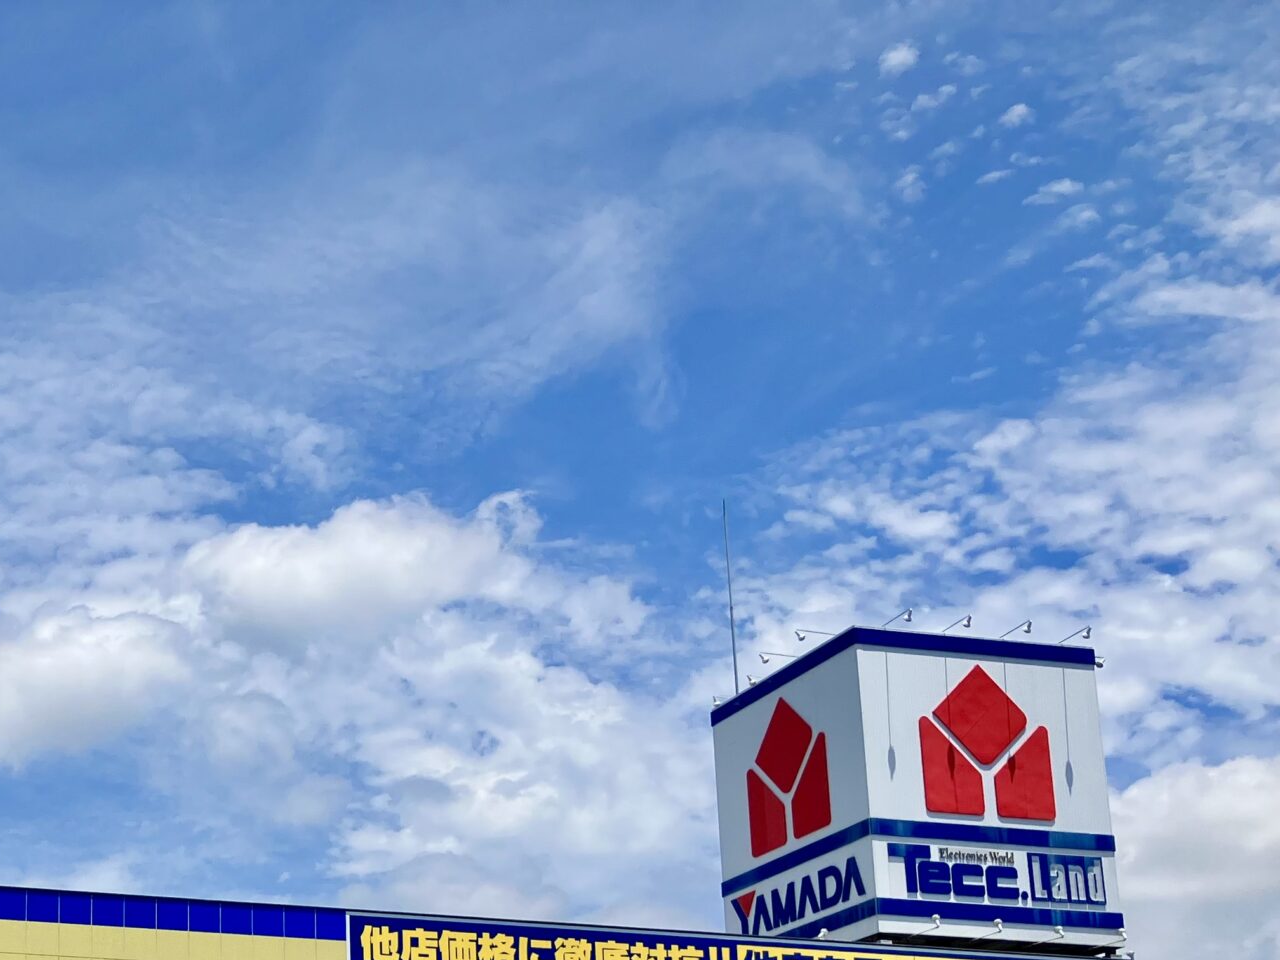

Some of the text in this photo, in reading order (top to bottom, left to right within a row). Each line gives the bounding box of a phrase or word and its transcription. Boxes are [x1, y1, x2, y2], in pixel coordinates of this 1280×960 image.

[938, 848, 1015, 865] Electronics World
[731, 856, 866, 935] YAMADA
